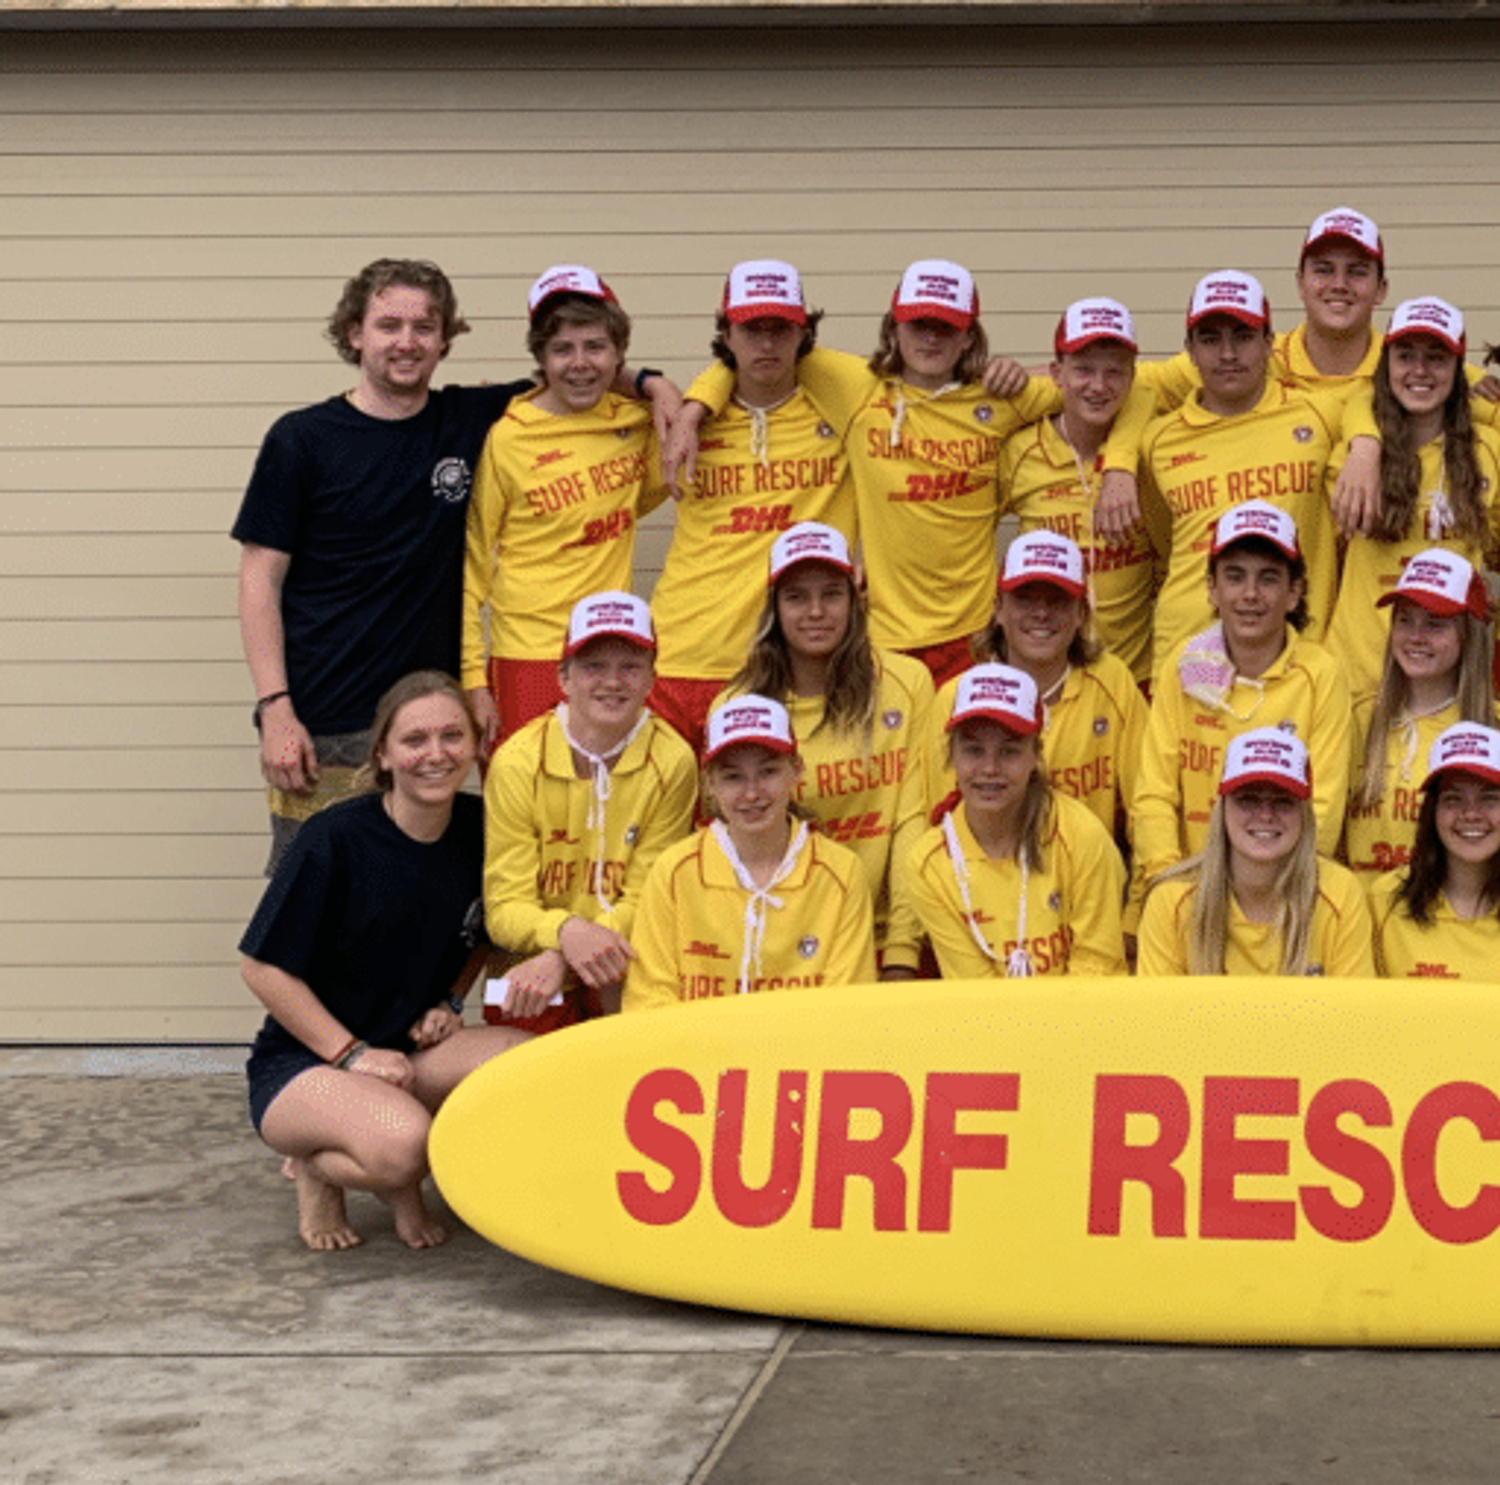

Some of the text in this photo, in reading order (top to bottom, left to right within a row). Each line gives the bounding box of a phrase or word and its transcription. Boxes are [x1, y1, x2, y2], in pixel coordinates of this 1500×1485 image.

[525, 472, 588, 517] SURF
[694, 456, 839, 499] SURF RESCUE
[1166, 461, 1318, 518] SURF RESCUE
[1048, 756, 1112, 799] ESCUE
[615, 1067, 1021, 1233] SURF
